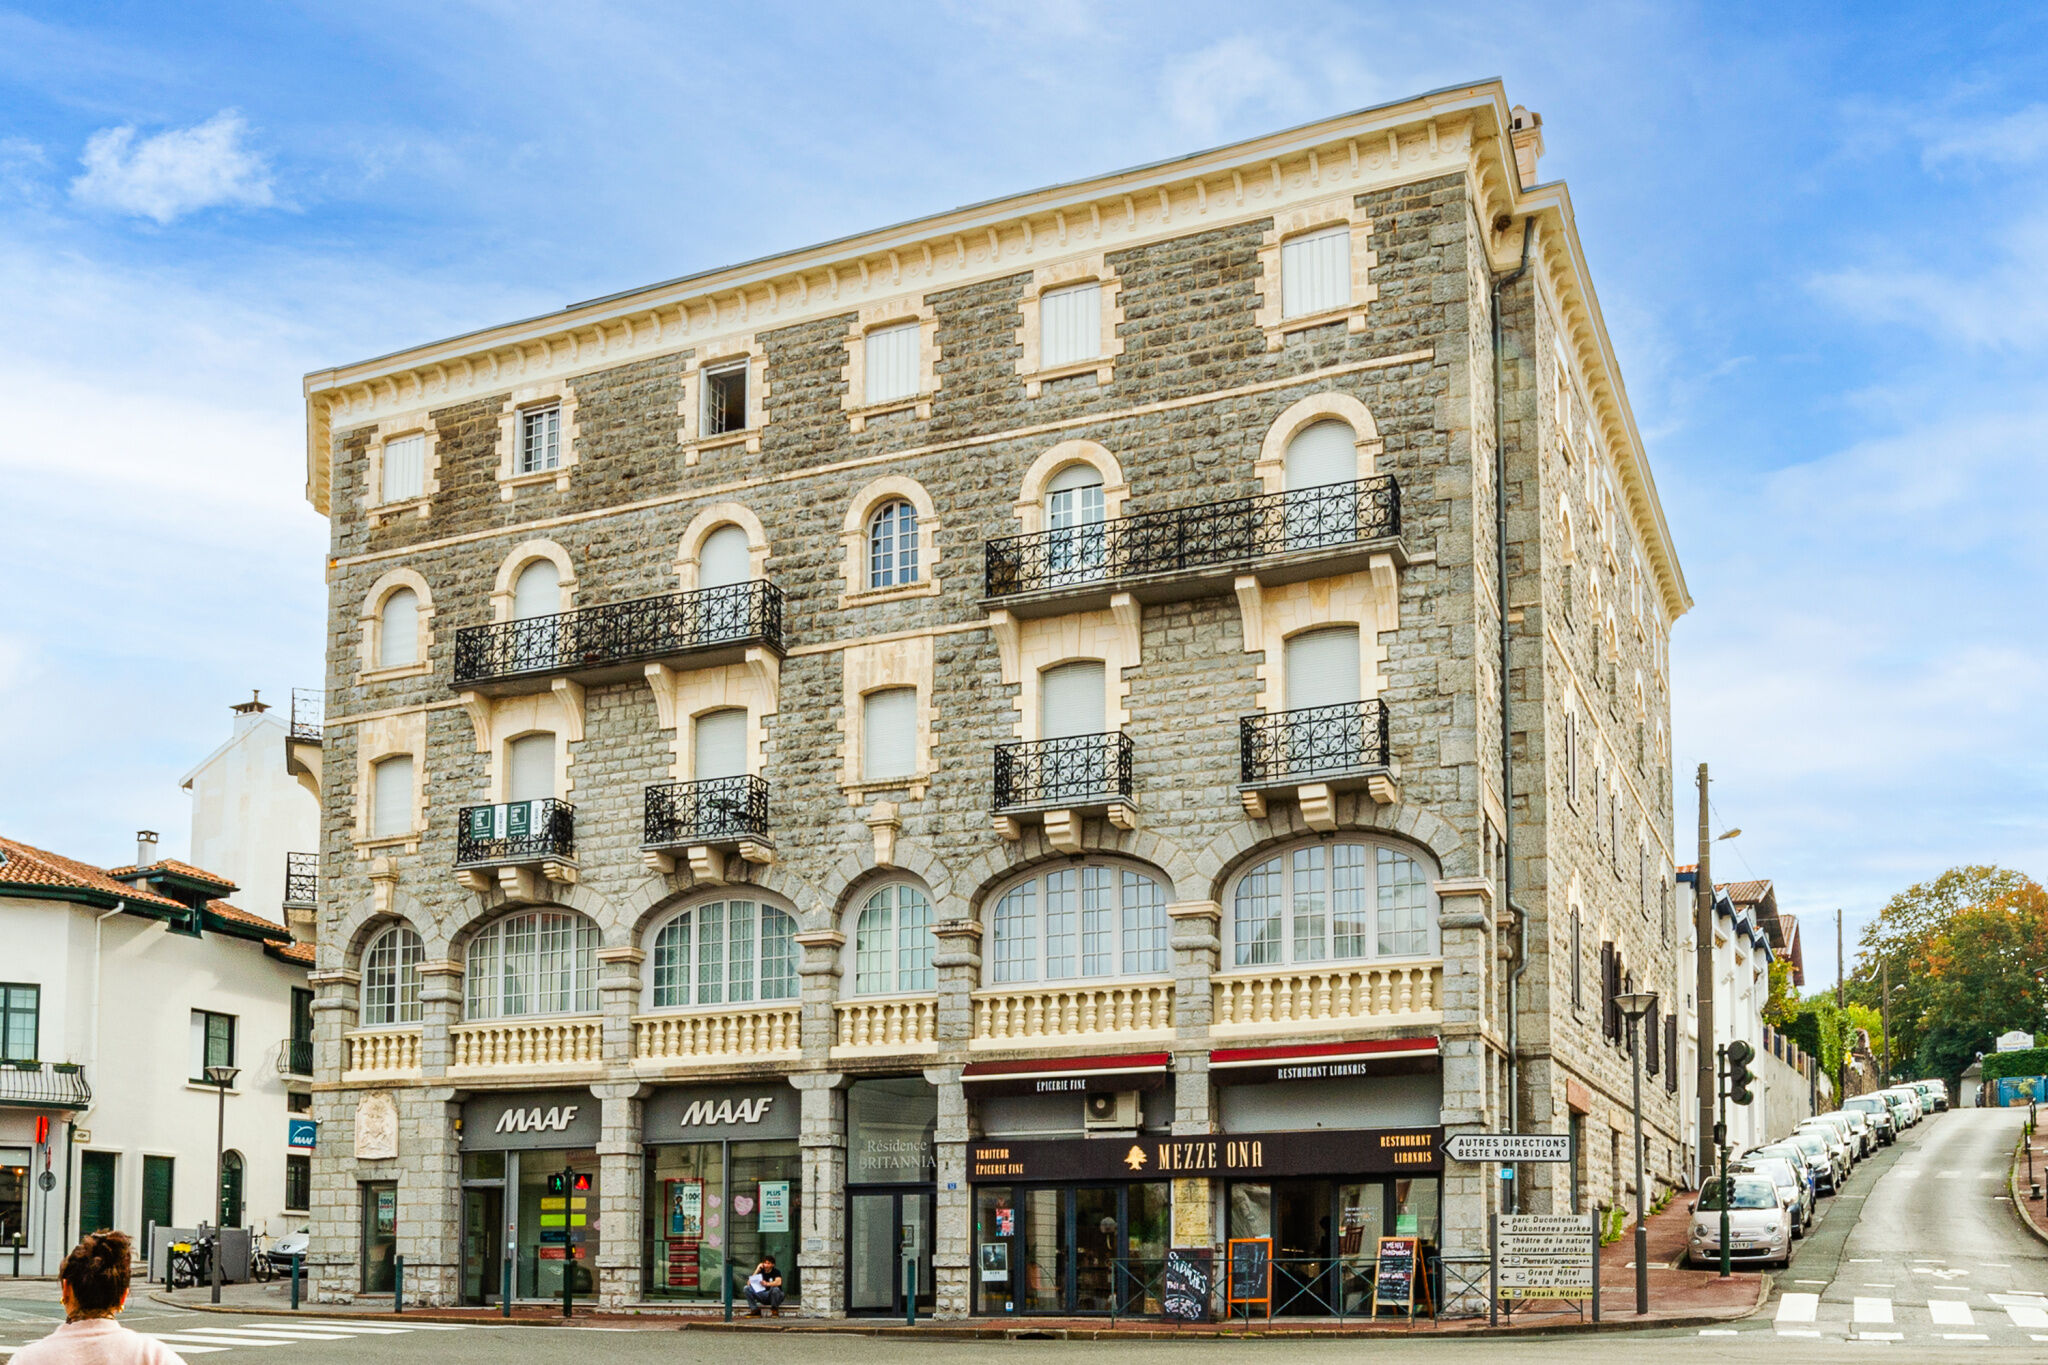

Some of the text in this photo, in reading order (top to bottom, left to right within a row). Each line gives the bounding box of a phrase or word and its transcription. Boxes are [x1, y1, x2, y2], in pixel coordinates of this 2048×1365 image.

[1278, 1063, 1367, 1080] RESTAURANT LIBANAIS
[1036, 1079, 1086, 1092] ÉPICERIE FINE
[681, 1097, 773, 1126] MAAF
[495, 1106, 578, 1133] MAAF
[292, 1136, 314, 1145] MAAF
[868, 1139, 928, 1152] Résidence
[1380, 1135, 1432, 1147] RESTAURANT
[1458, 1139, 1567, 1147] AUTRES DIRECTIONS
[976, 1148, 1009, 1160] TRAITEUR
[1158, 1140, 1263, 1170] MEZZE ONA
[1394, 1152, 1432, 1163] LIBANAIS
[1458, 1149, 1562, 1157] BESTE NORABIDEAK
[975, 1163, 1024, 1175] ÉPICERIE FINE
[1563, 1225, 1591, 1233] parkea
[1549, 1257, 1579, 1265] Vacances
[1527, 1268, 1580, 1276] Grand Hôtel
[1524, 1288, 1582, 1297] Mosaik Hôtel
